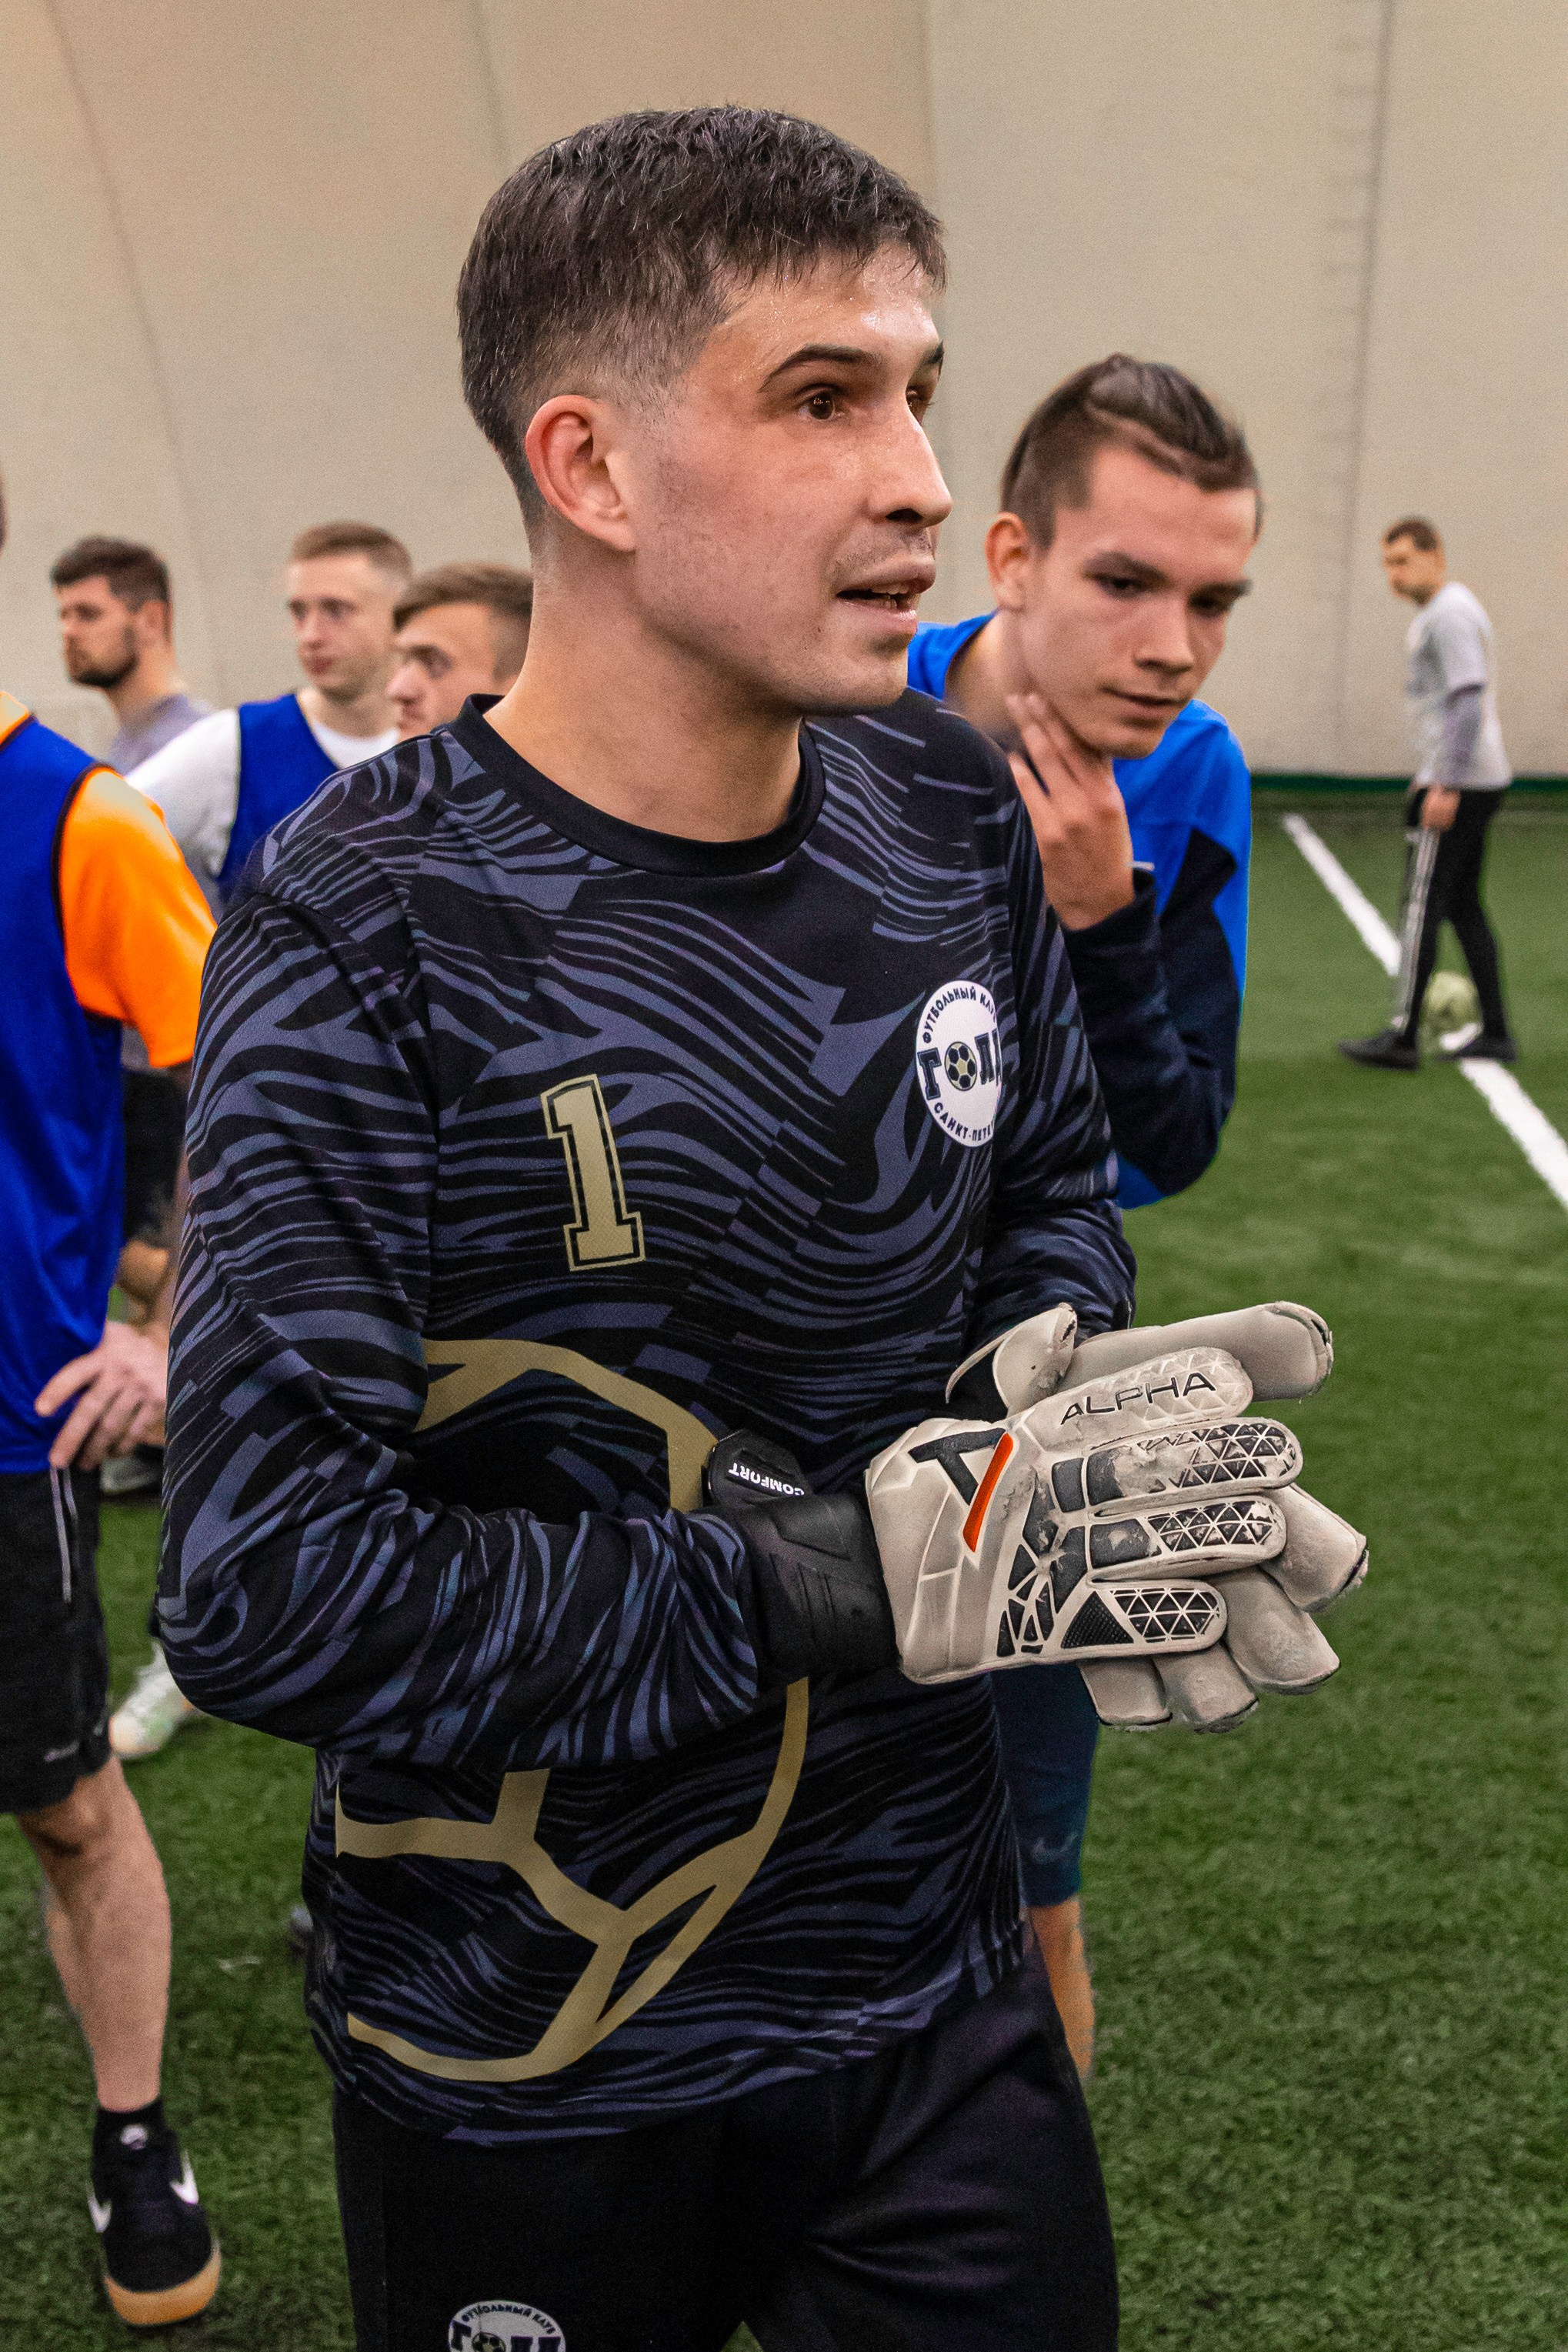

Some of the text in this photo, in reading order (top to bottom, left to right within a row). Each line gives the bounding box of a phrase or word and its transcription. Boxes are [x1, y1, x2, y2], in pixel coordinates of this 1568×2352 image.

[922, 986, 976, 1043] ФУТБОЛЬНЫЙ
[540, 1074, 646, 1271] 1
[1061, 1373, 1216, 1425] ALPHA
[729, 1462, 804, 1496] COMFORT
